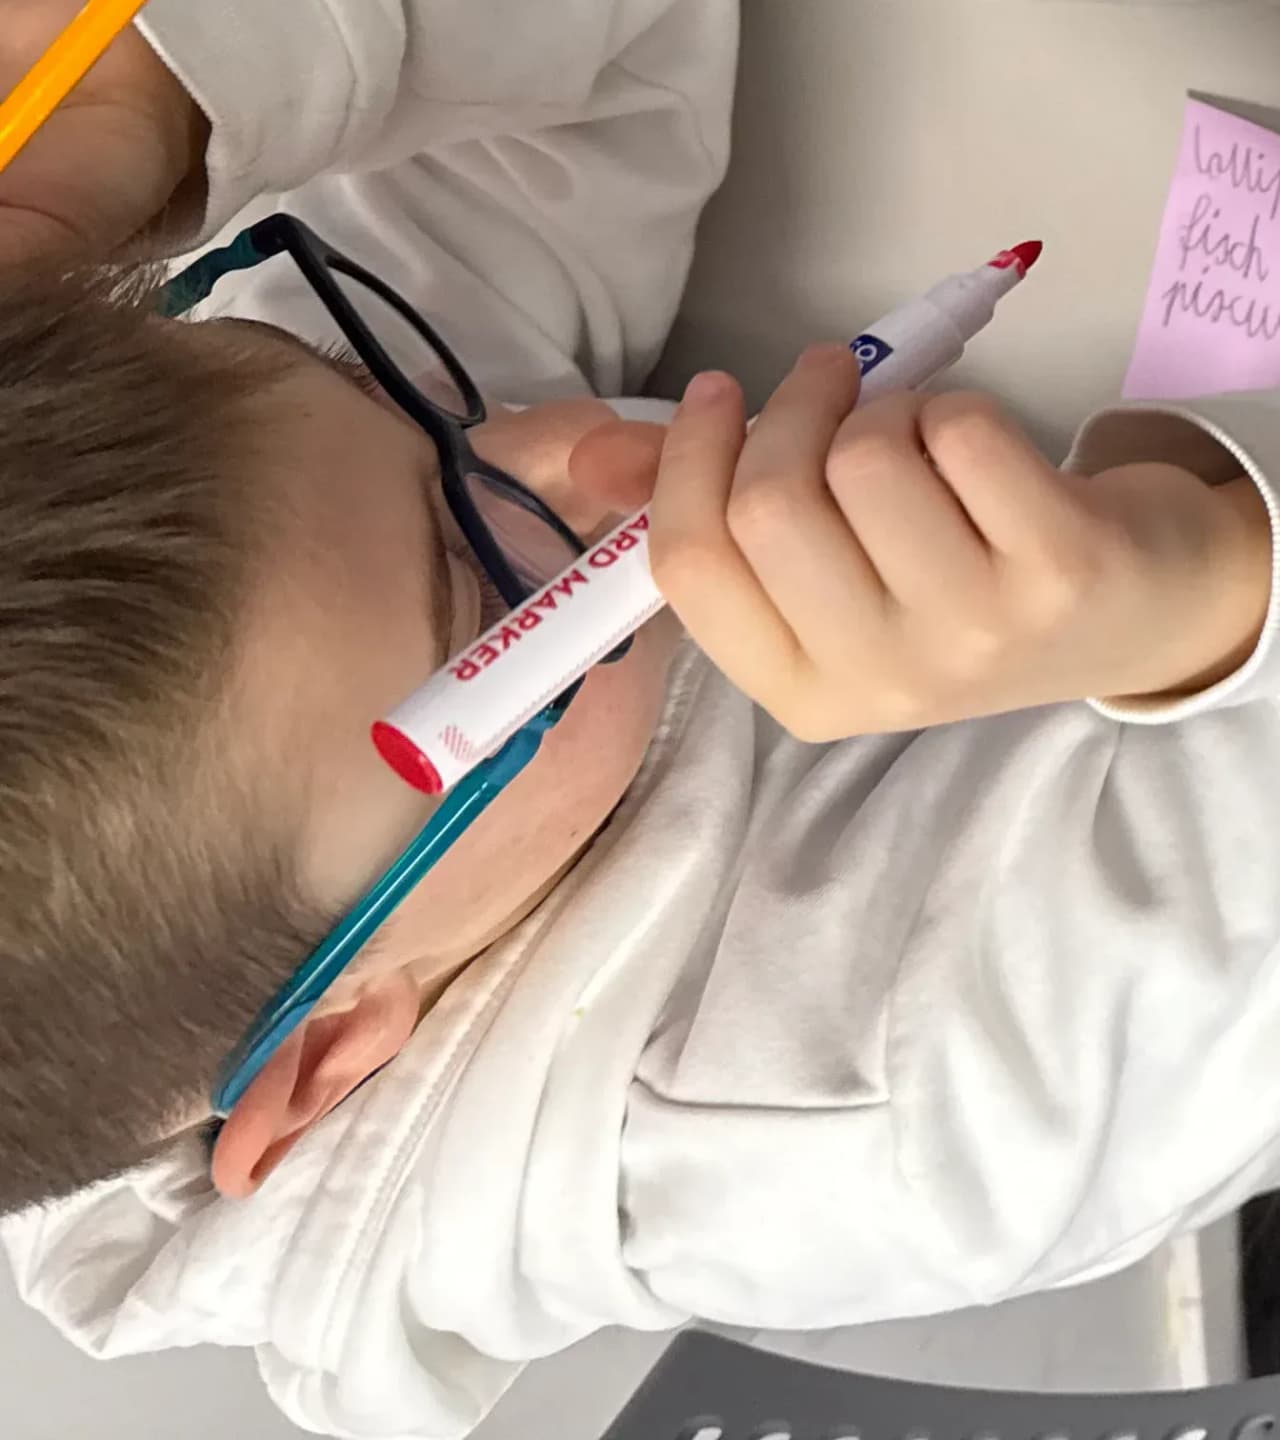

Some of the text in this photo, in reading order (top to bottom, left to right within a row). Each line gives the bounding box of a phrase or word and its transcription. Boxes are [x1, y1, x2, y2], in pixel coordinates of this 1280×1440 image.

[1178, 193, 1270, 283] fisch
[450, 512, 650, 681] ARD MARKER
